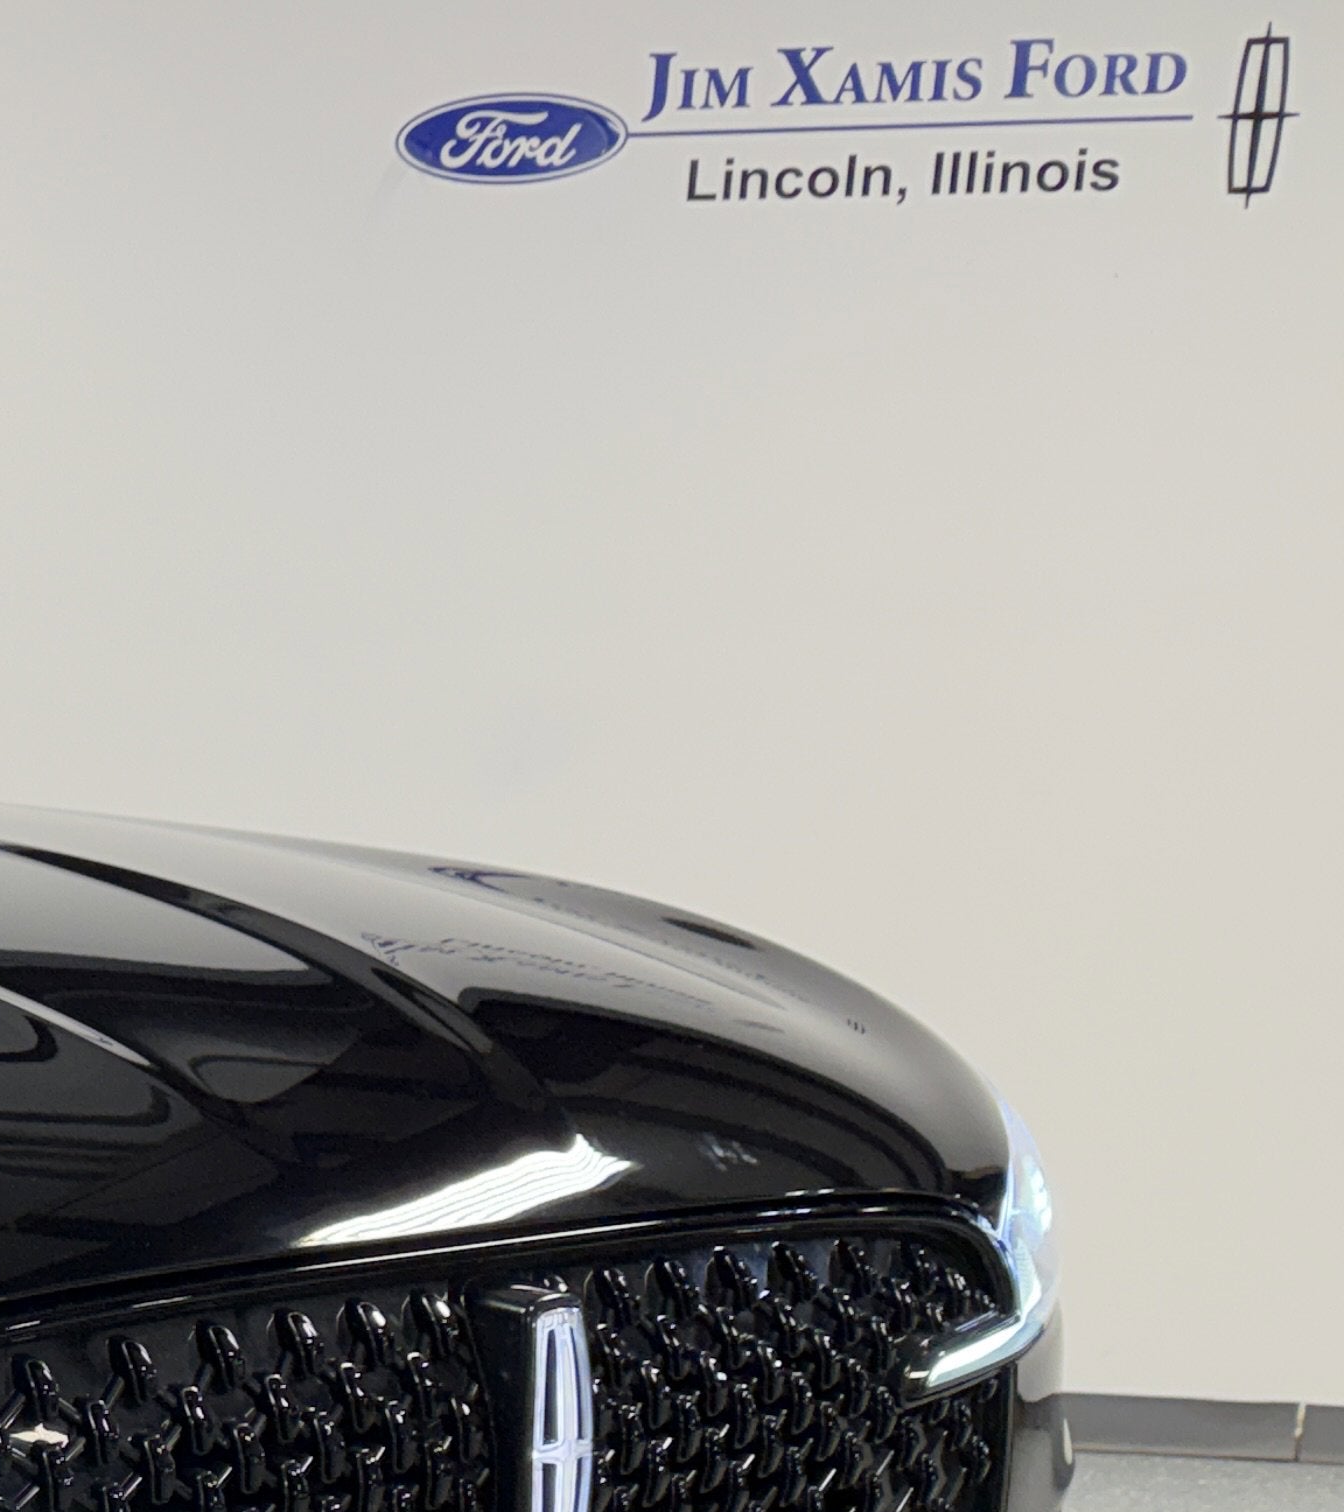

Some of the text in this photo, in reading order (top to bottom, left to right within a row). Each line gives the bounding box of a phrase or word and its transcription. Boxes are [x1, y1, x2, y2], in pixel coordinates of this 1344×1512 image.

[641, 39, 1187, 122] JIM XAMIS FORD
[440, 109, 583, 169] Ford
[686, 147, 1120, 205] Lincoln, Illinois
